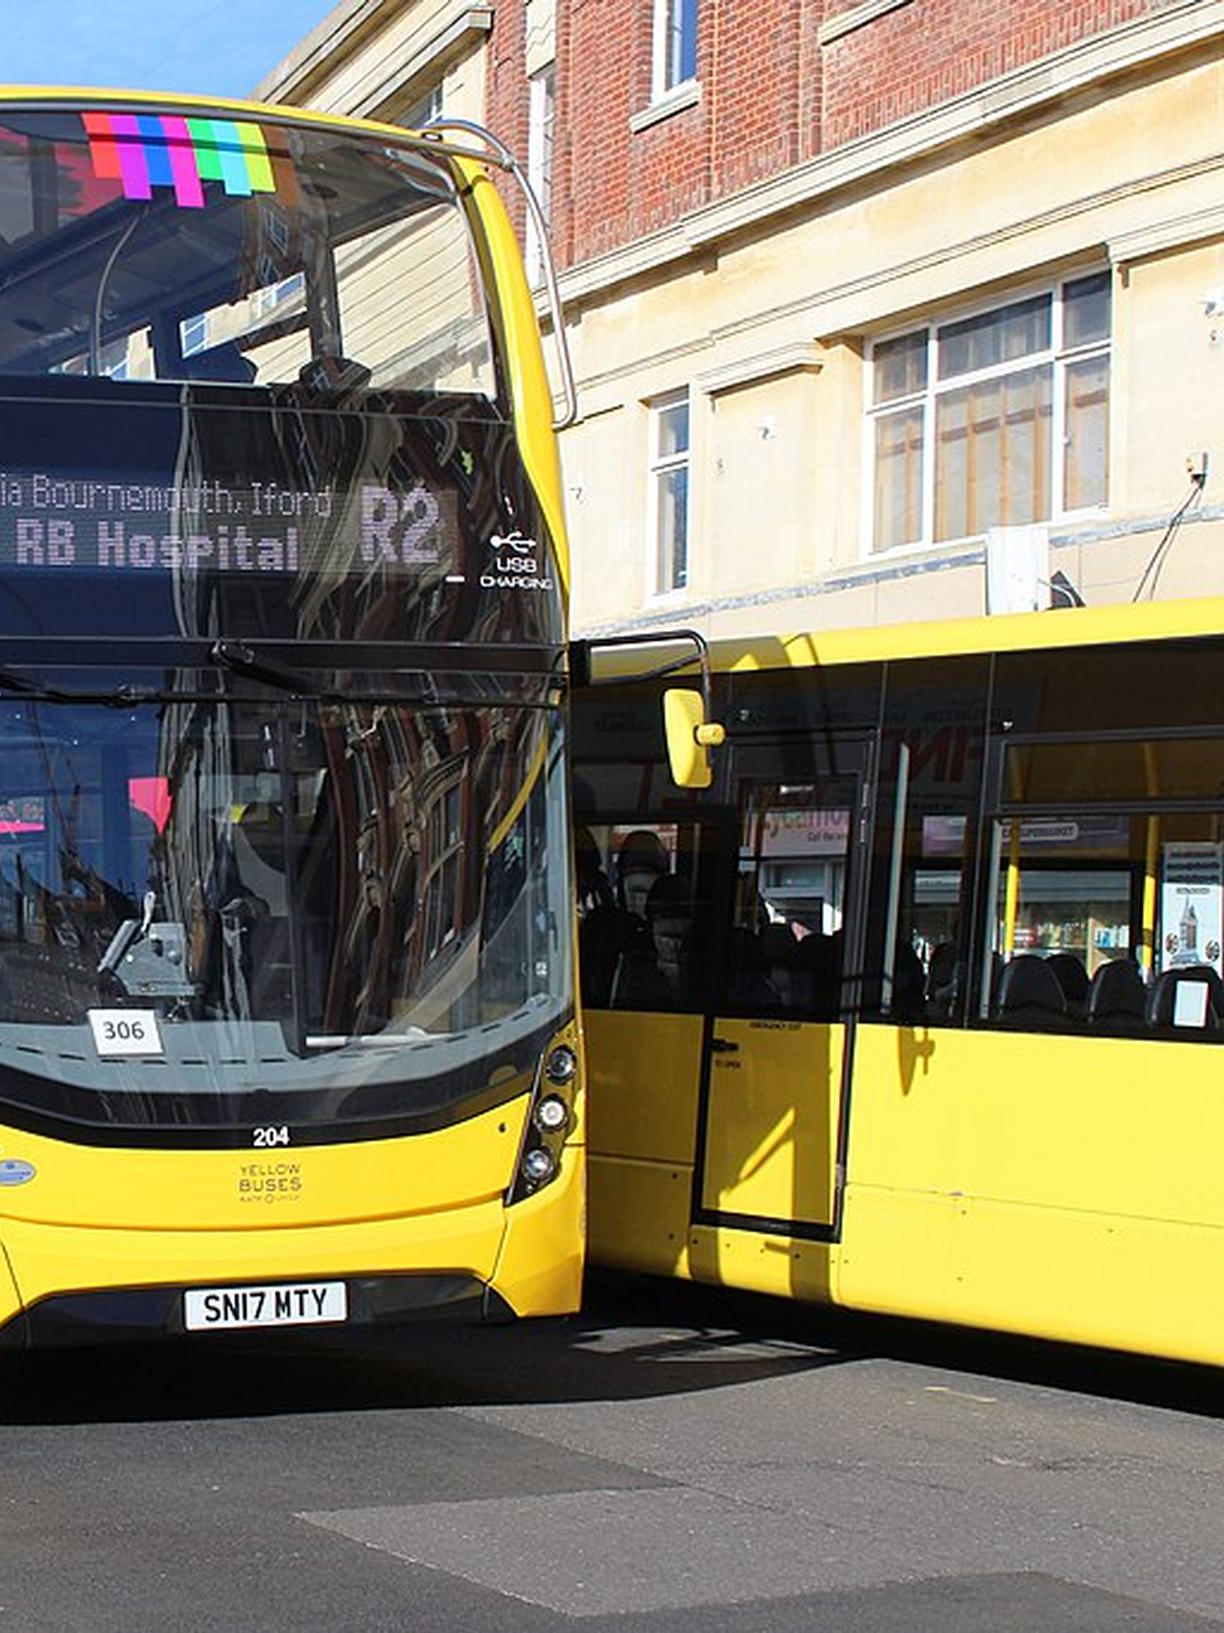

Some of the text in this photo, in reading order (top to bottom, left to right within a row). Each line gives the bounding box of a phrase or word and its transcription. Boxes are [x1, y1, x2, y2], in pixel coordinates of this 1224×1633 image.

[251, 481, 333, 518] Iford
[361, 485, 440, 563] R2
[16, 518, 298, 572] RB Hospital
[496, 557, 537, 573] USB
[480, 575, 554, 590] CHARGING
[103, 1021, 145, 1039] 306
[253, 1127, 290, 1146] 204
[239, 1164, 301, 1176] YELLOW
[239, 1177, 302, 1192] BUSES
[204, 1288, 327, 1322] SN17 MTY
